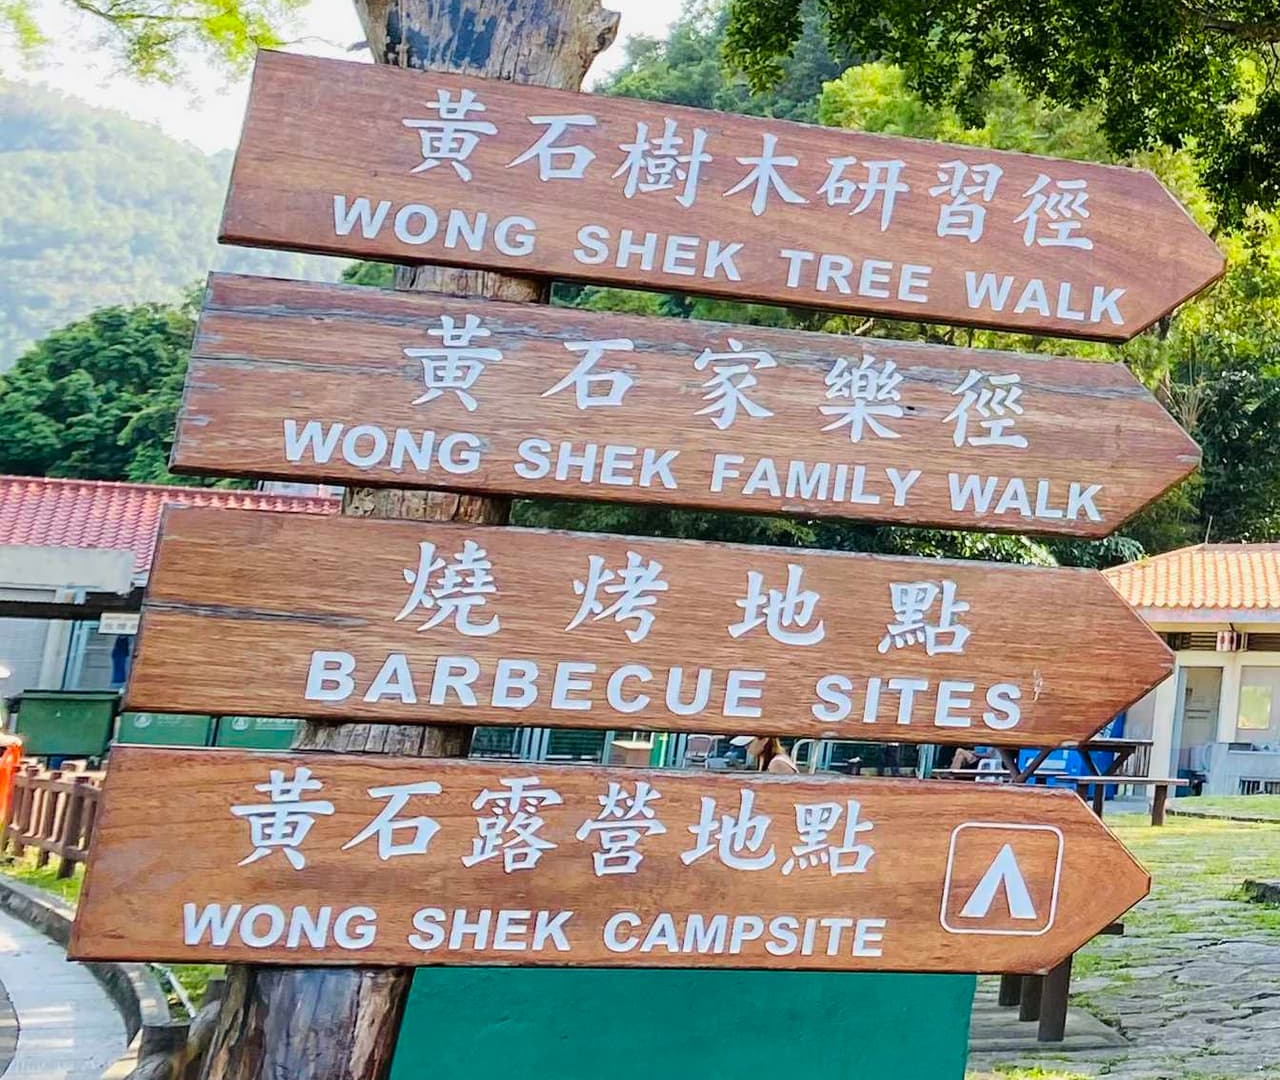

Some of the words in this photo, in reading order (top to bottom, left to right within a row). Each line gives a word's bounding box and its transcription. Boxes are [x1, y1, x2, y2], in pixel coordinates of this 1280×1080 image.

[332, 194, 537, 256] WONG
[572, 224, 743, 282] SHEK
[780, 248, 932, 304] TREE
[964, 271, 1125, 326] WALK
[284, 419, 482, 474] WONG
[513, 436, 679, 489] SHEK
[711, 453, 922, 506] FAMILY
[947, 472, 1105, 521] WALK
[304, 650, 767, 718] BARBECUE
[811, 674, 1022, 729] SITES
[183, 903, 377, 951] WONG
[408, 907, 572, 953] SHEK
[603, 911, 886, 957] CAMPSITE
